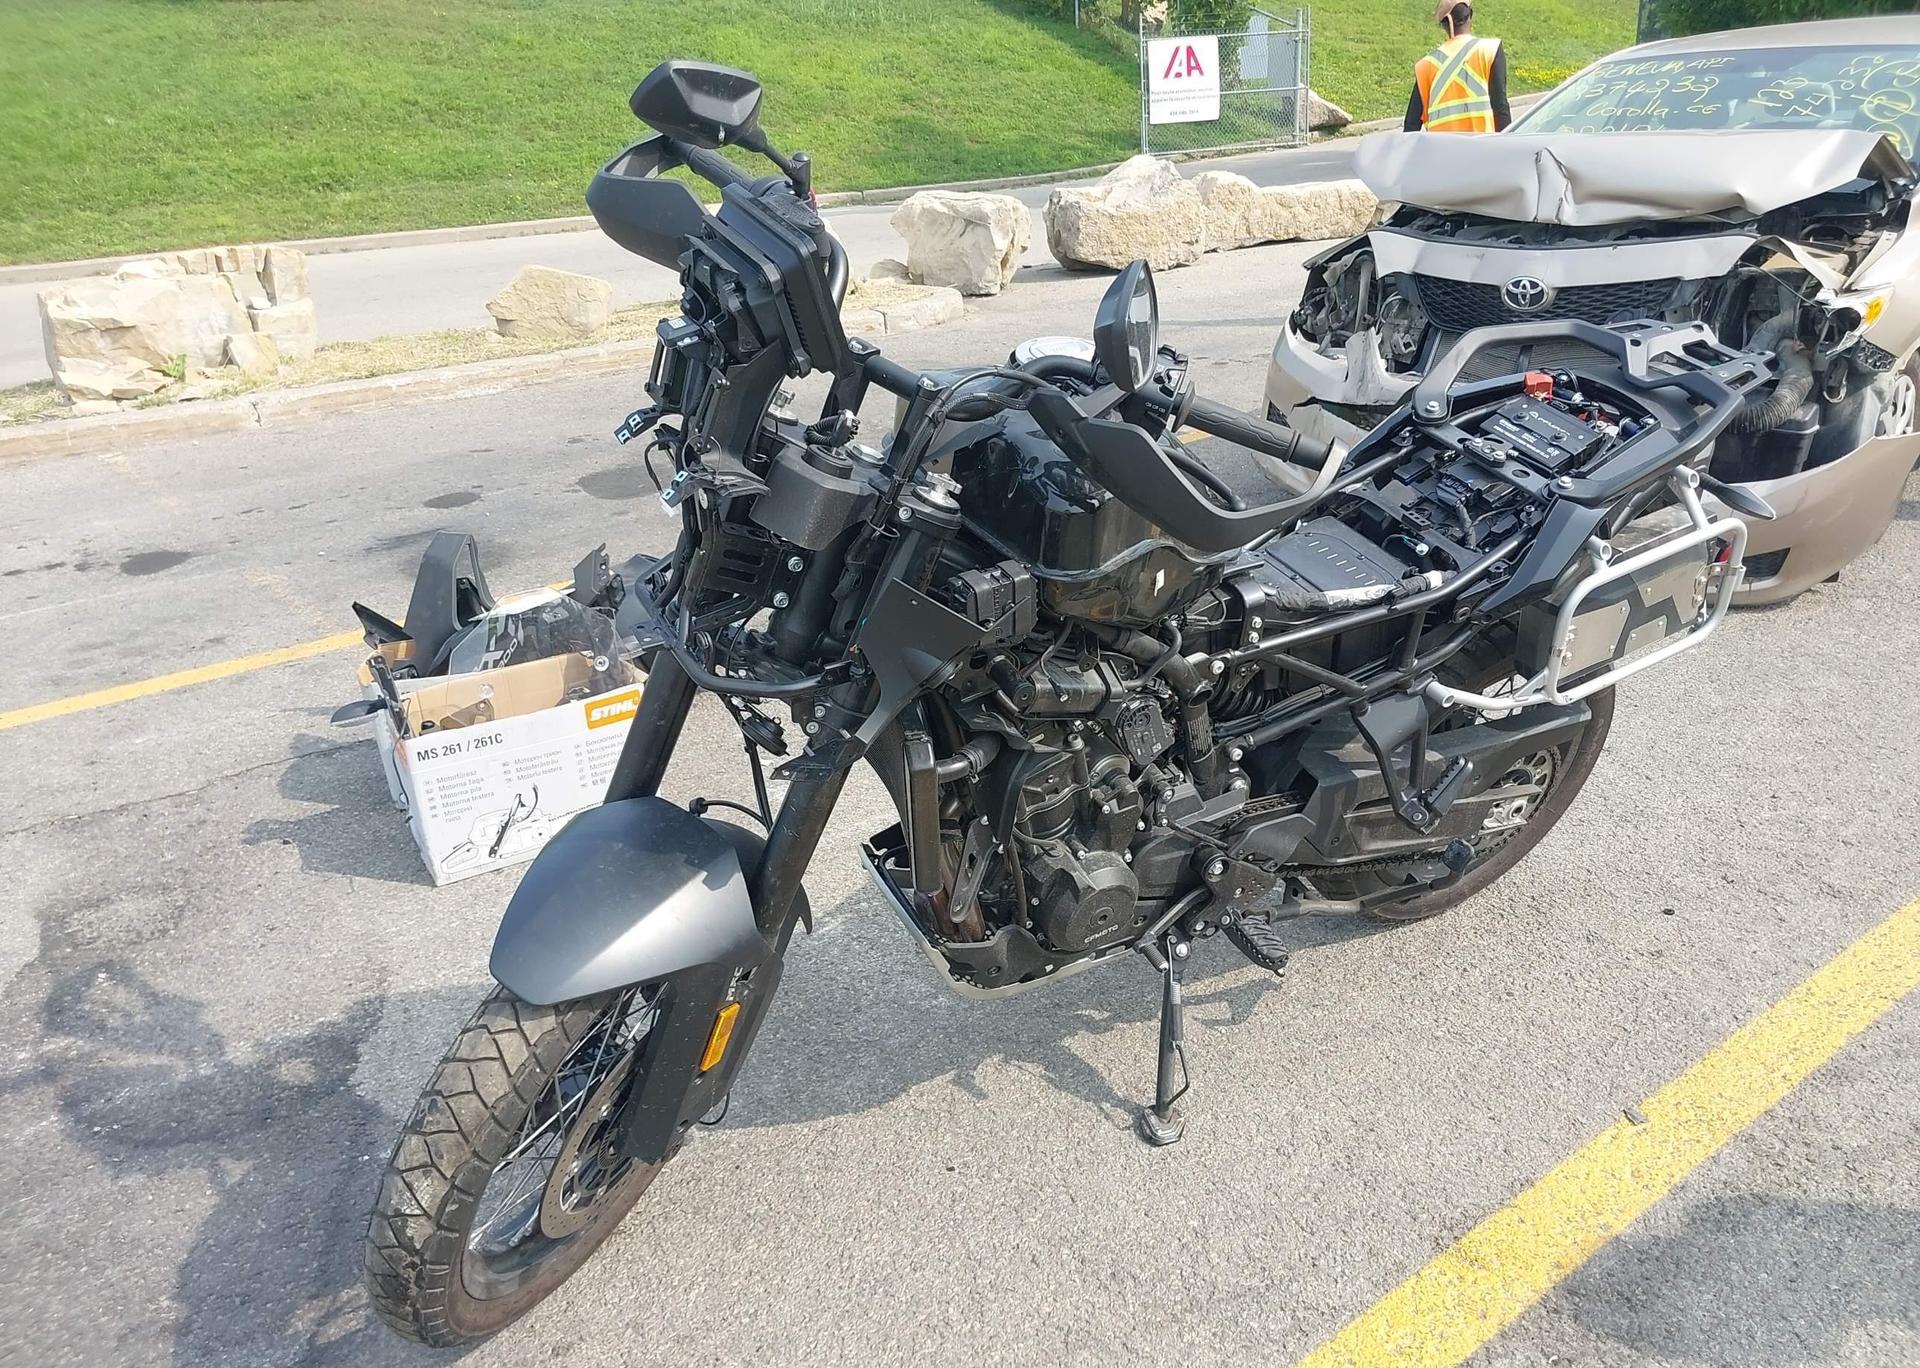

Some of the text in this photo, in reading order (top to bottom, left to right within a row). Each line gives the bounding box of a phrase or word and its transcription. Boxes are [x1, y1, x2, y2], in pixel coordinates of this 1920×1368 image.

[590, 698, 638, 722] STIHL
[417, 747, 439, 762] MS
[441, 742, 462, 757] 261
[473, 733, 503, 749] 261C
